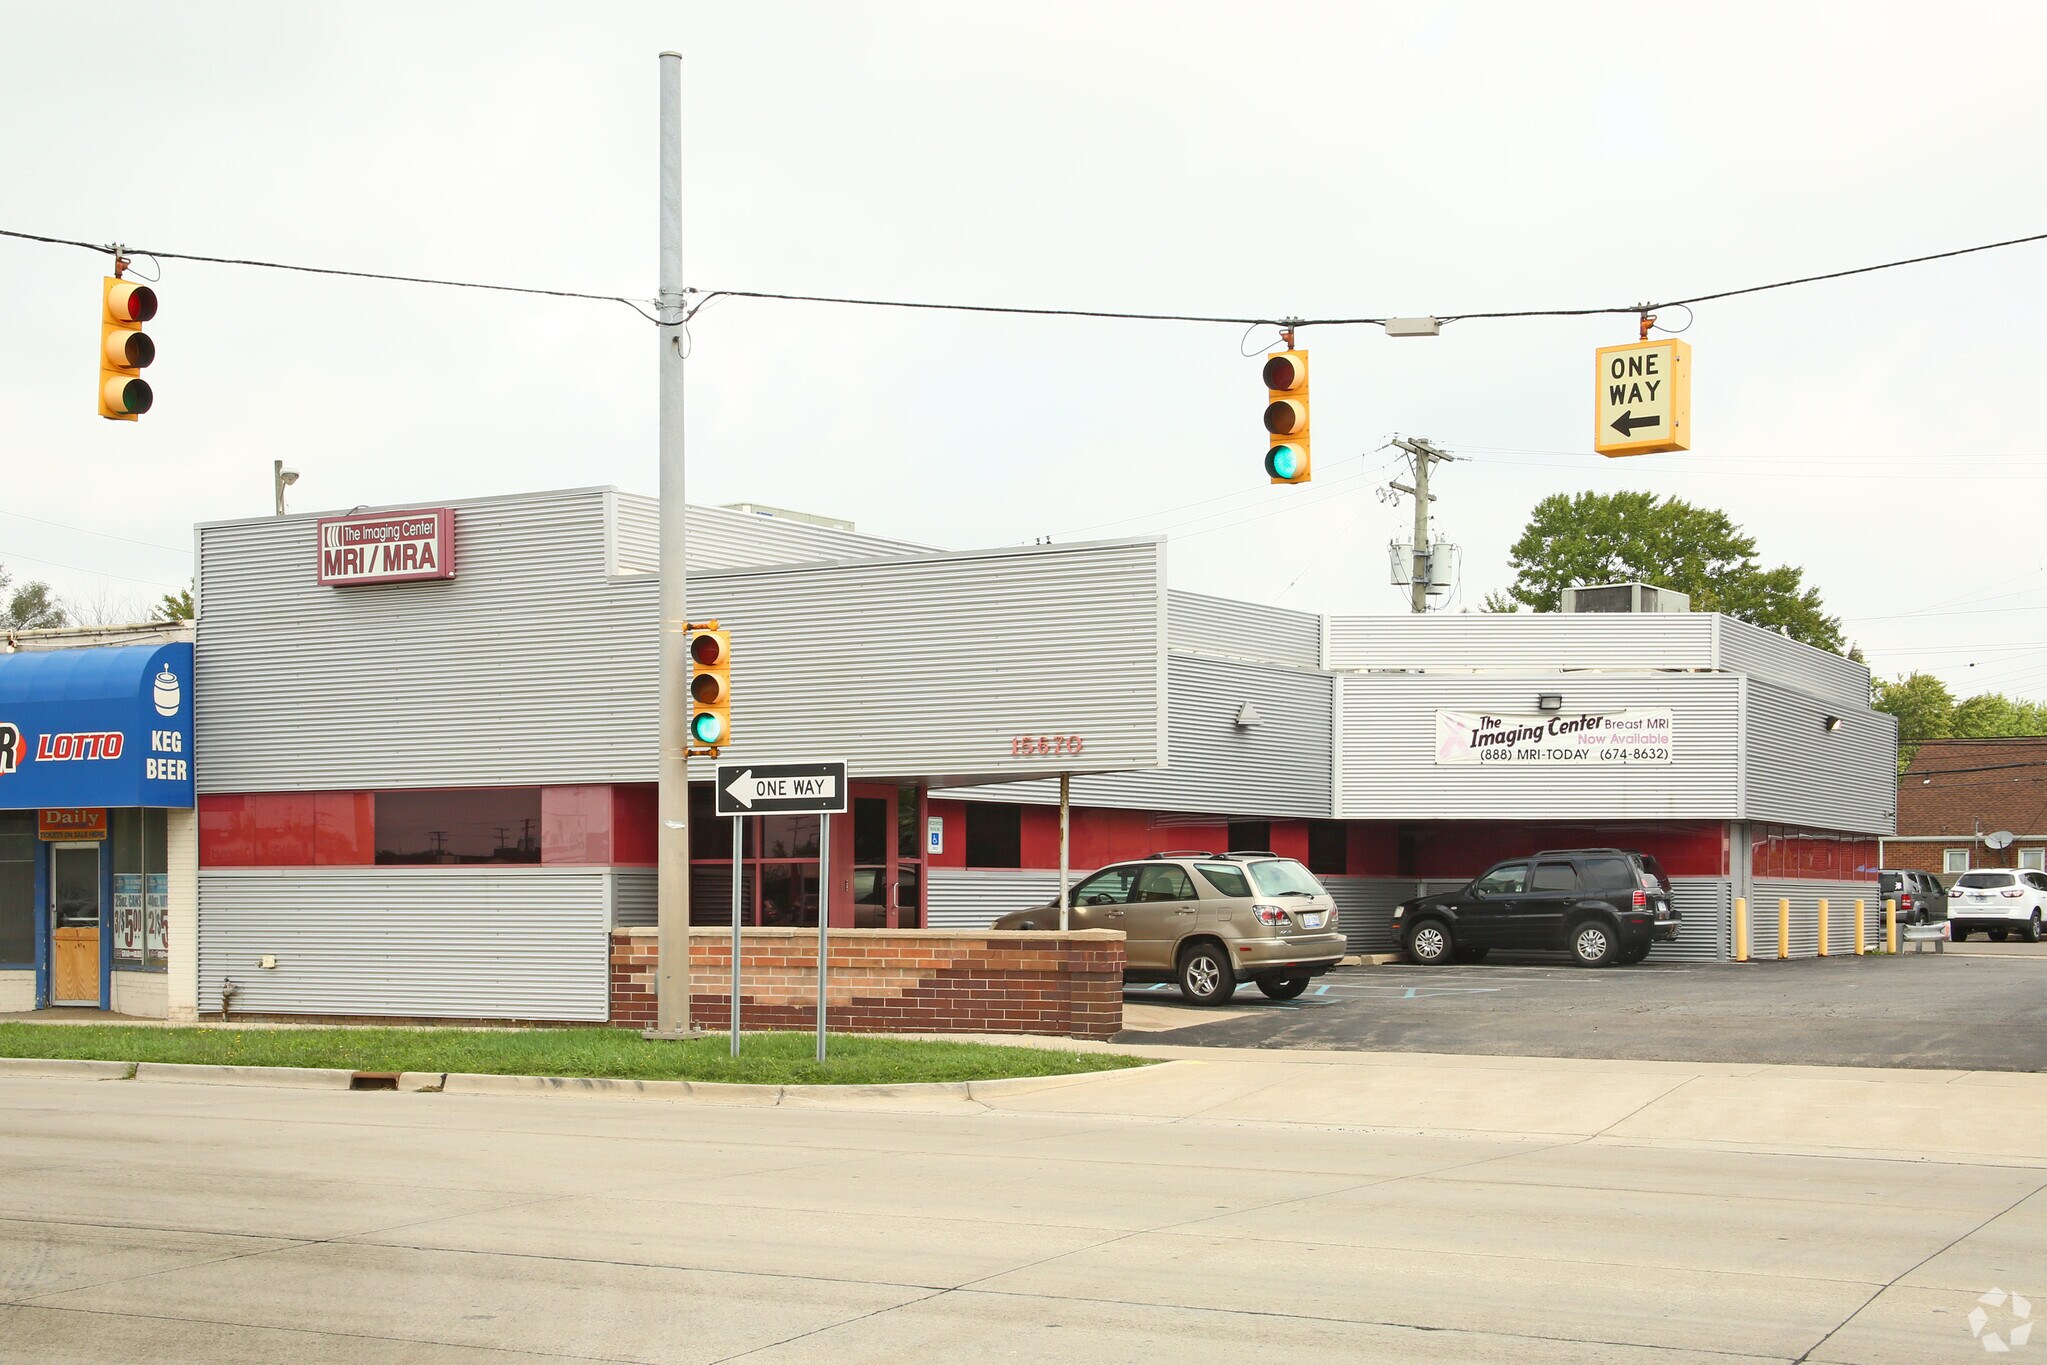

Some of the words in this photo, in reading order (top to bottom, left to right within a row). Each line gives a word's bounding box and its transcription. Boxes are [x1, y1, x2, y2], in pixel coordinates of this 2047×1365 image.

[1611, 353, 1659, 379] ONE
[1609, 380, 1661, 406] WAY
[344, 527, 361, 542] The
[362, 523, 400, 542] Imaging
[402, 521, 434, 537] Center
[1469, 724, 1545, 748] Imaging
[1547, 714, 1604, 737] Center
[1605, 719, 1643, 730] Breast
[1647, 718, 1670, 729] MRI
[1480, 715, 1502, 730] The
[35, 732, 124, 762] LOTTO
[152, 730, 182, 753] KEG
[1011, 735, 1084, 757] 15670
[1578, 733, 1606, 745] Now
[1610, 733, 1669, 745] Available
[1480, 748, 1512, 761] (888)
[1517, 748, 1590, 761] MRI-TODAY
[1600, 748, 1669, 761] (674-8632)
[146, 758, 187, 781] BEER
[756, 780, 787, 797] ONE
[793, 779, 825, 795] WAY
[46, 810, 100, 827] Daily
